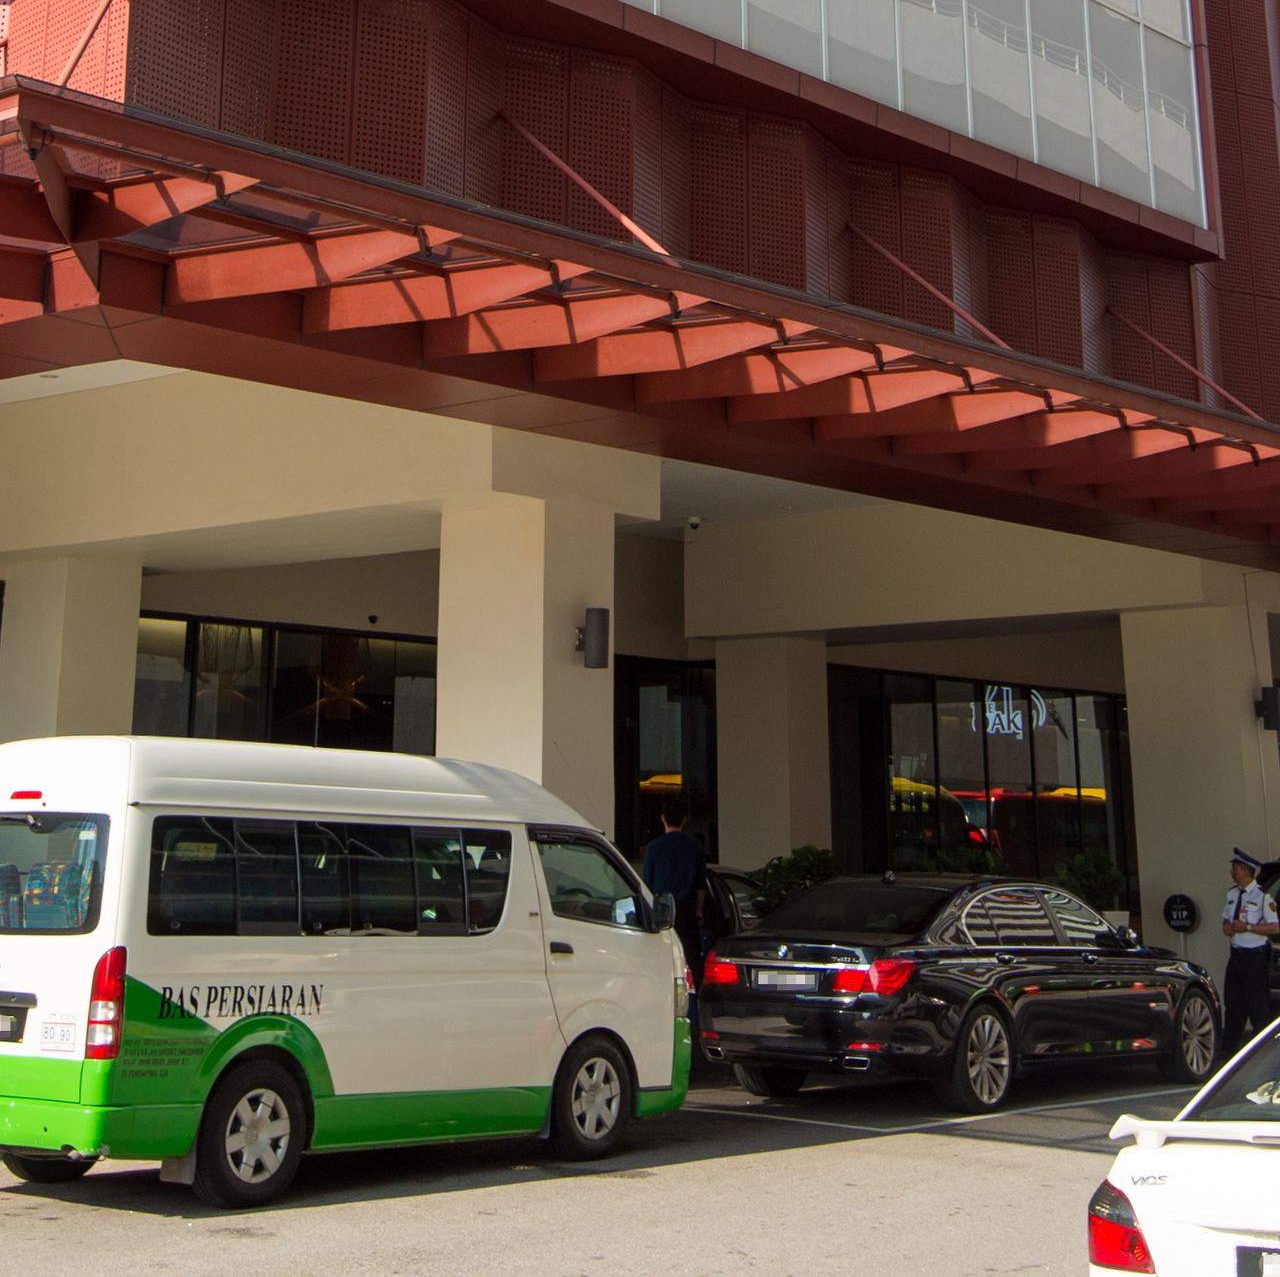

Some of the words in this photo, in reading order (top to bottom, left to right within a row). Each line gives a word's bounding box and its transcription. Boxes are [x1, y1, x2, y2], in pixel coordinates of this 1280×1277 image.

[1171, 910, 1188, 919] VIP
[158, 986, 200, 1019] BAS
[204, 984, 324, 1018] PERSIARAN
